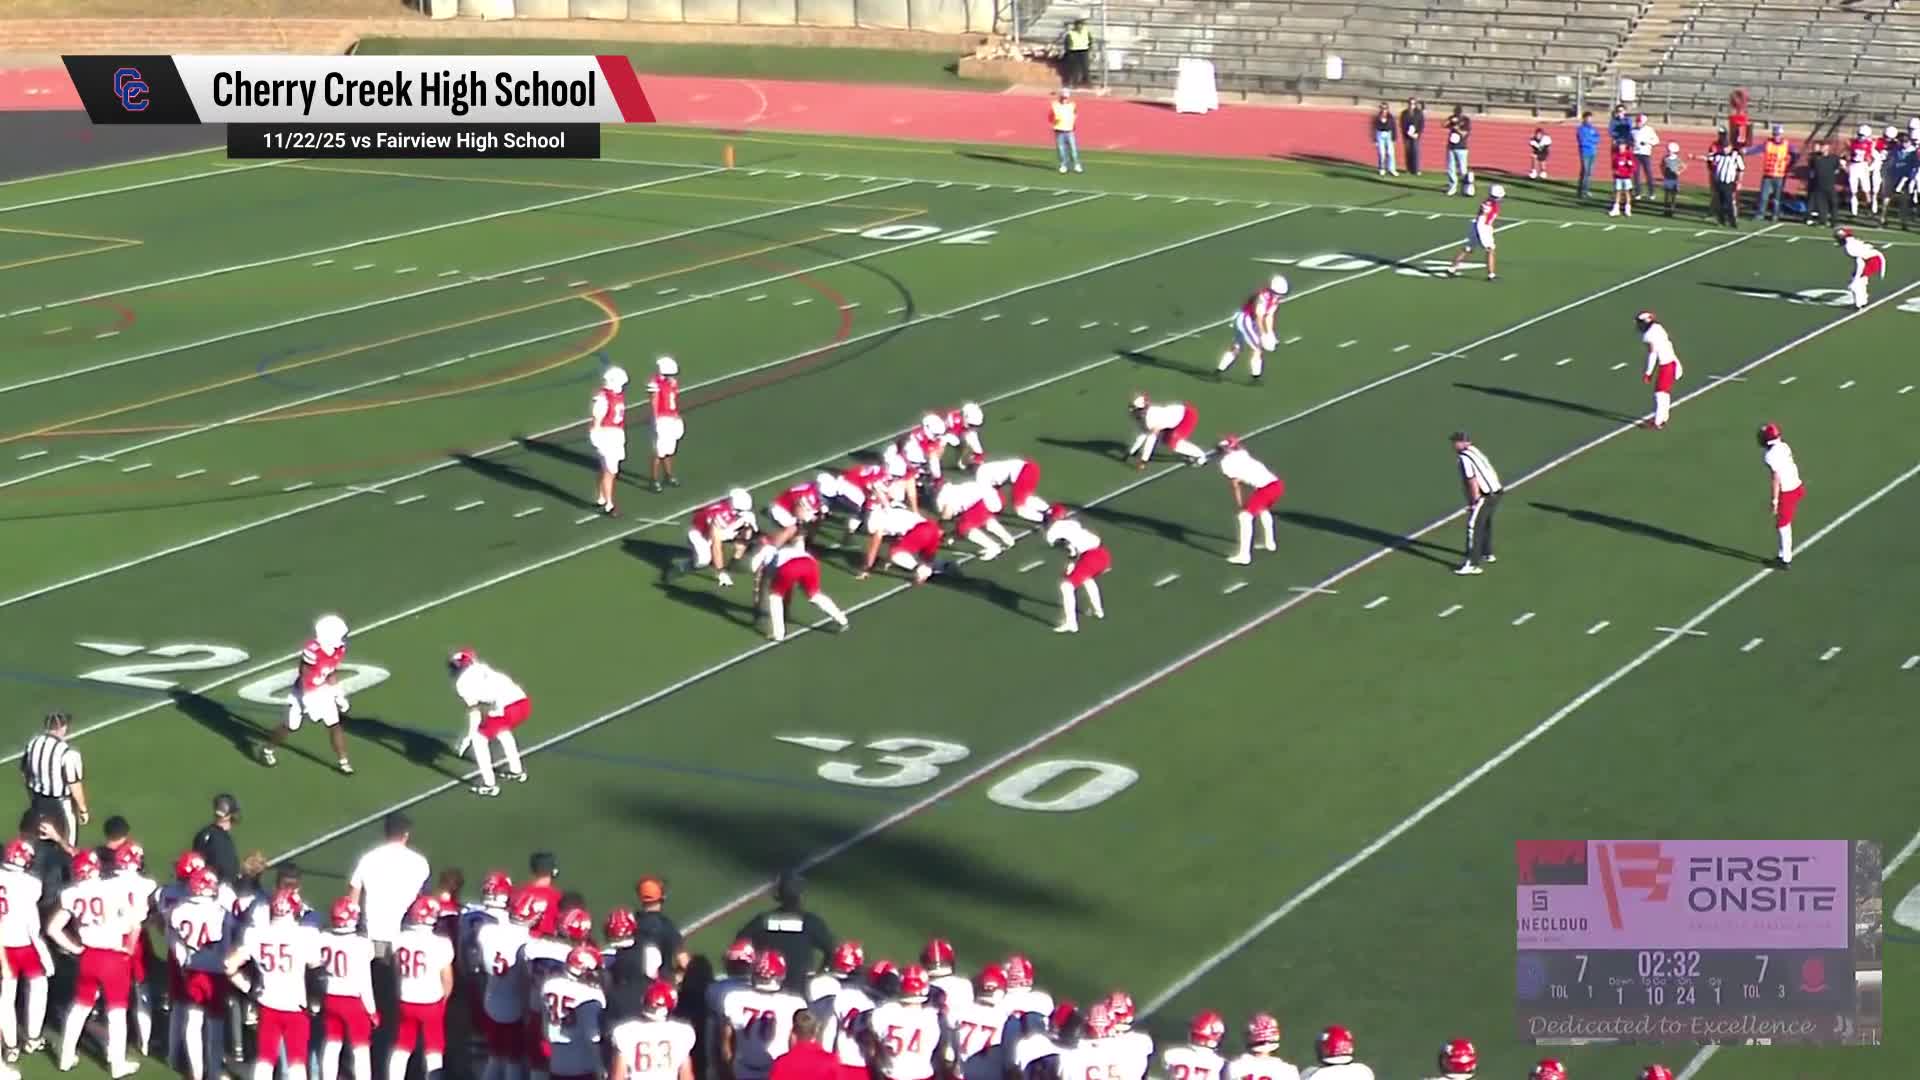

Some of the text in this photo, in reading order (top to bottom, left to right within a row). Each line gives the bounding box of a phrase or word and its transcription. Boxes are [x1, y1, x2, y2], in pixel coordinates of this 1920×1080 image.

[817, 737, 1140, 812] 30
[73, 896, 105, 926] 29
[179, 920, 211, 947] 24
[259, 943, 294, 973] 55
[320, 946, 348, 977] 20
[886, 1024, 922, 1056] 54
[960, 1020, 998, 1056] 77
[634, 1040, 673, 1073] 63
